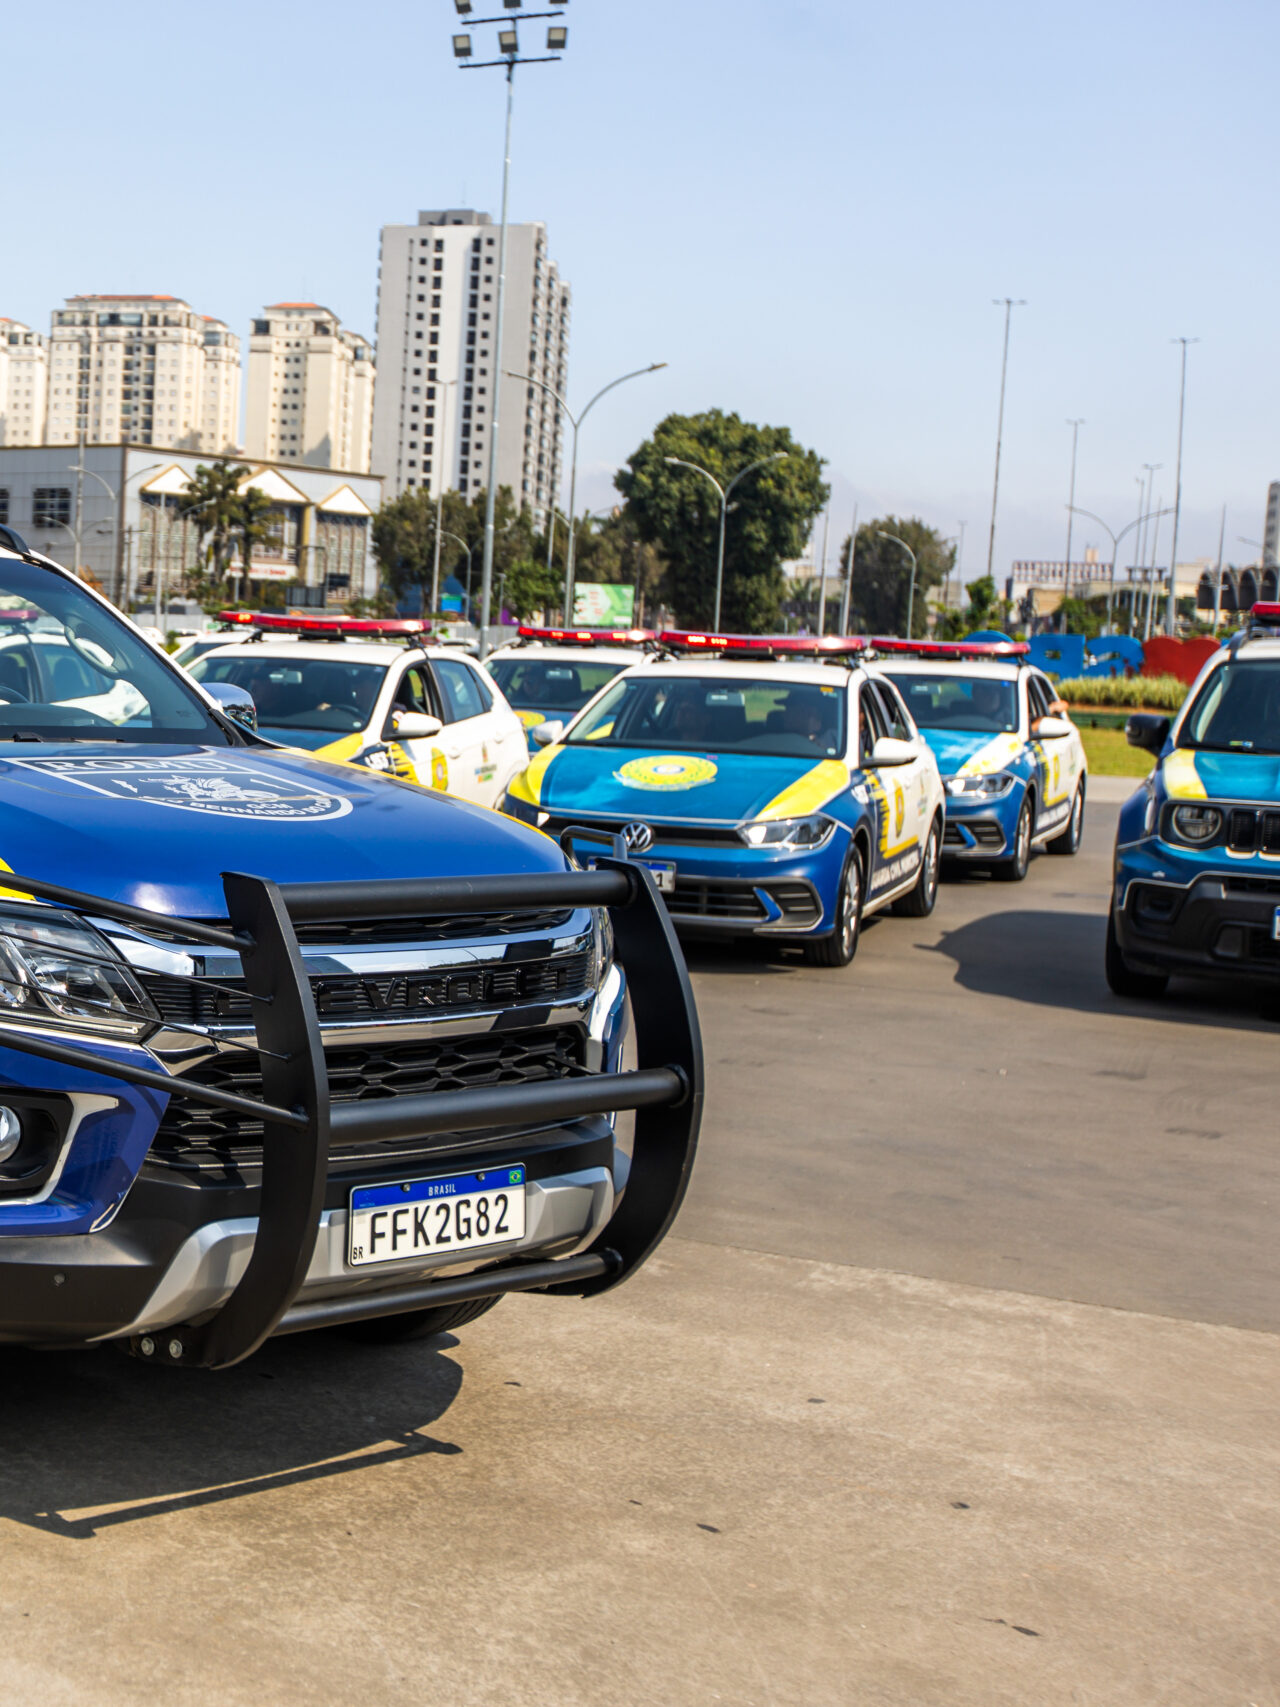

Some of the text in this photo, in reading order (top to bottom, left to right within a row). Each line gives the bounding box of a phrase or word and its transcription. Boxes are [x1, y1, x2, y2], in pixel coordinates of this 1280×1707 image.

[34, 760, 228, 771] ROMU
[428, 1183, 457, 1197] BRASIL
[370, 1193, 509, 1255] FFK2G82
[353, 1246, 364, 1260] BR
